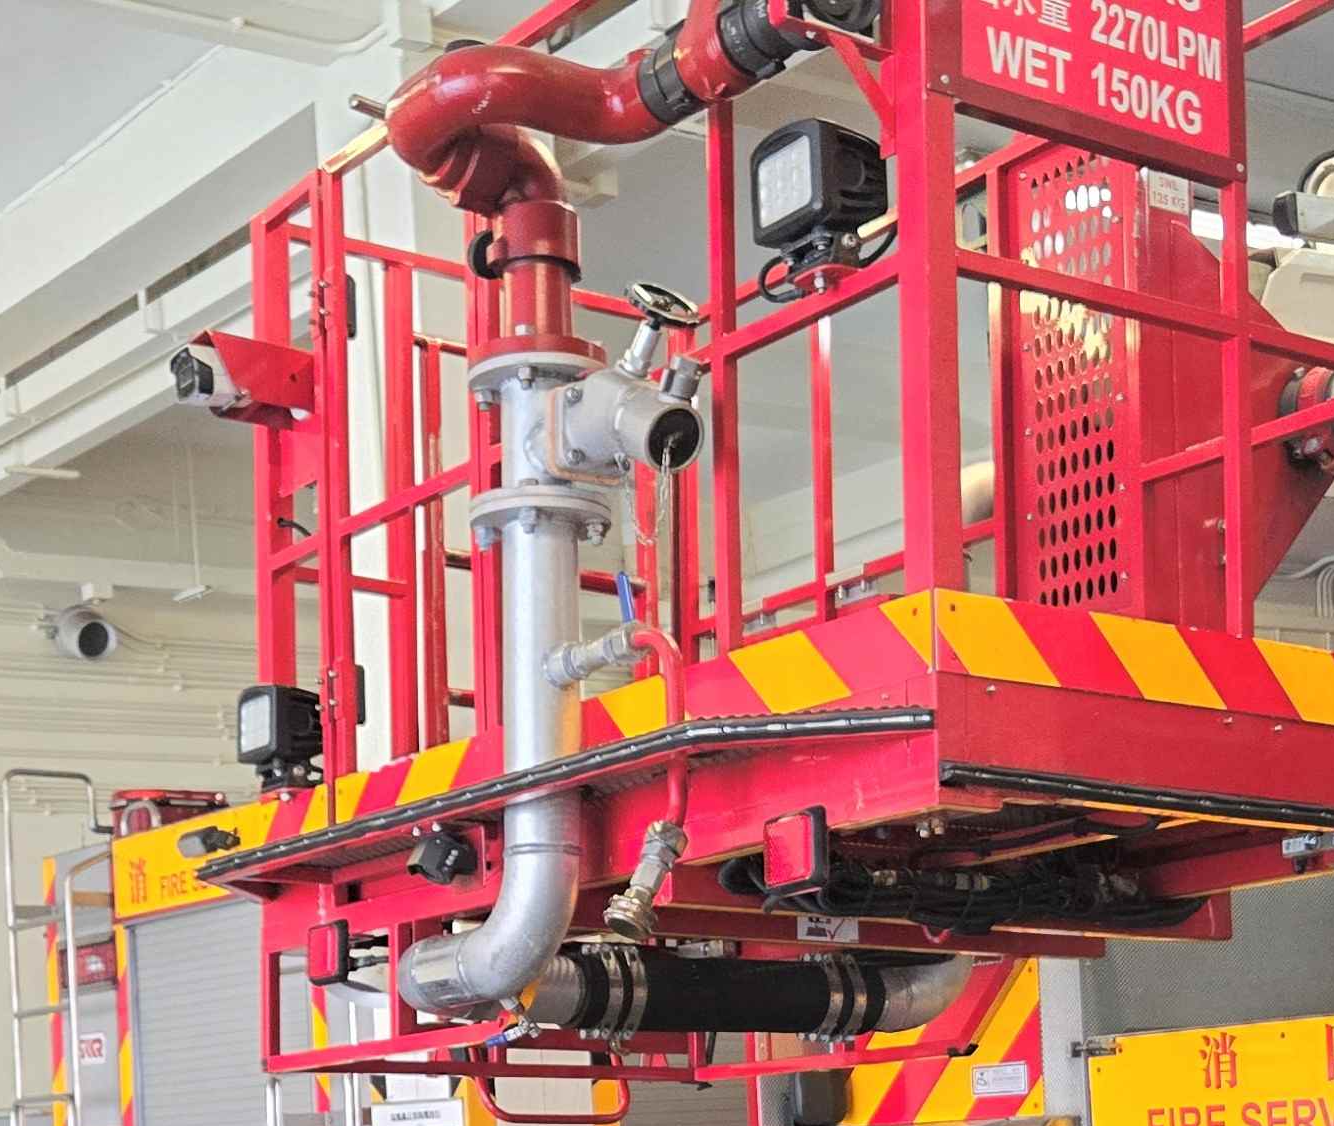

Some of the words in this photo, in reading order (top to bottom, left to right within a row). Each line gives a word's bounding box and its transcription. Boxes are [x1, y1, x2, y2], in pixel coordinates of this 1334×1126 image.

[986, 26, 1072, 94] WET
[1091, 62, 1203, 135] 150KG
[1091, 0, 1221, 82] 2270LPM
